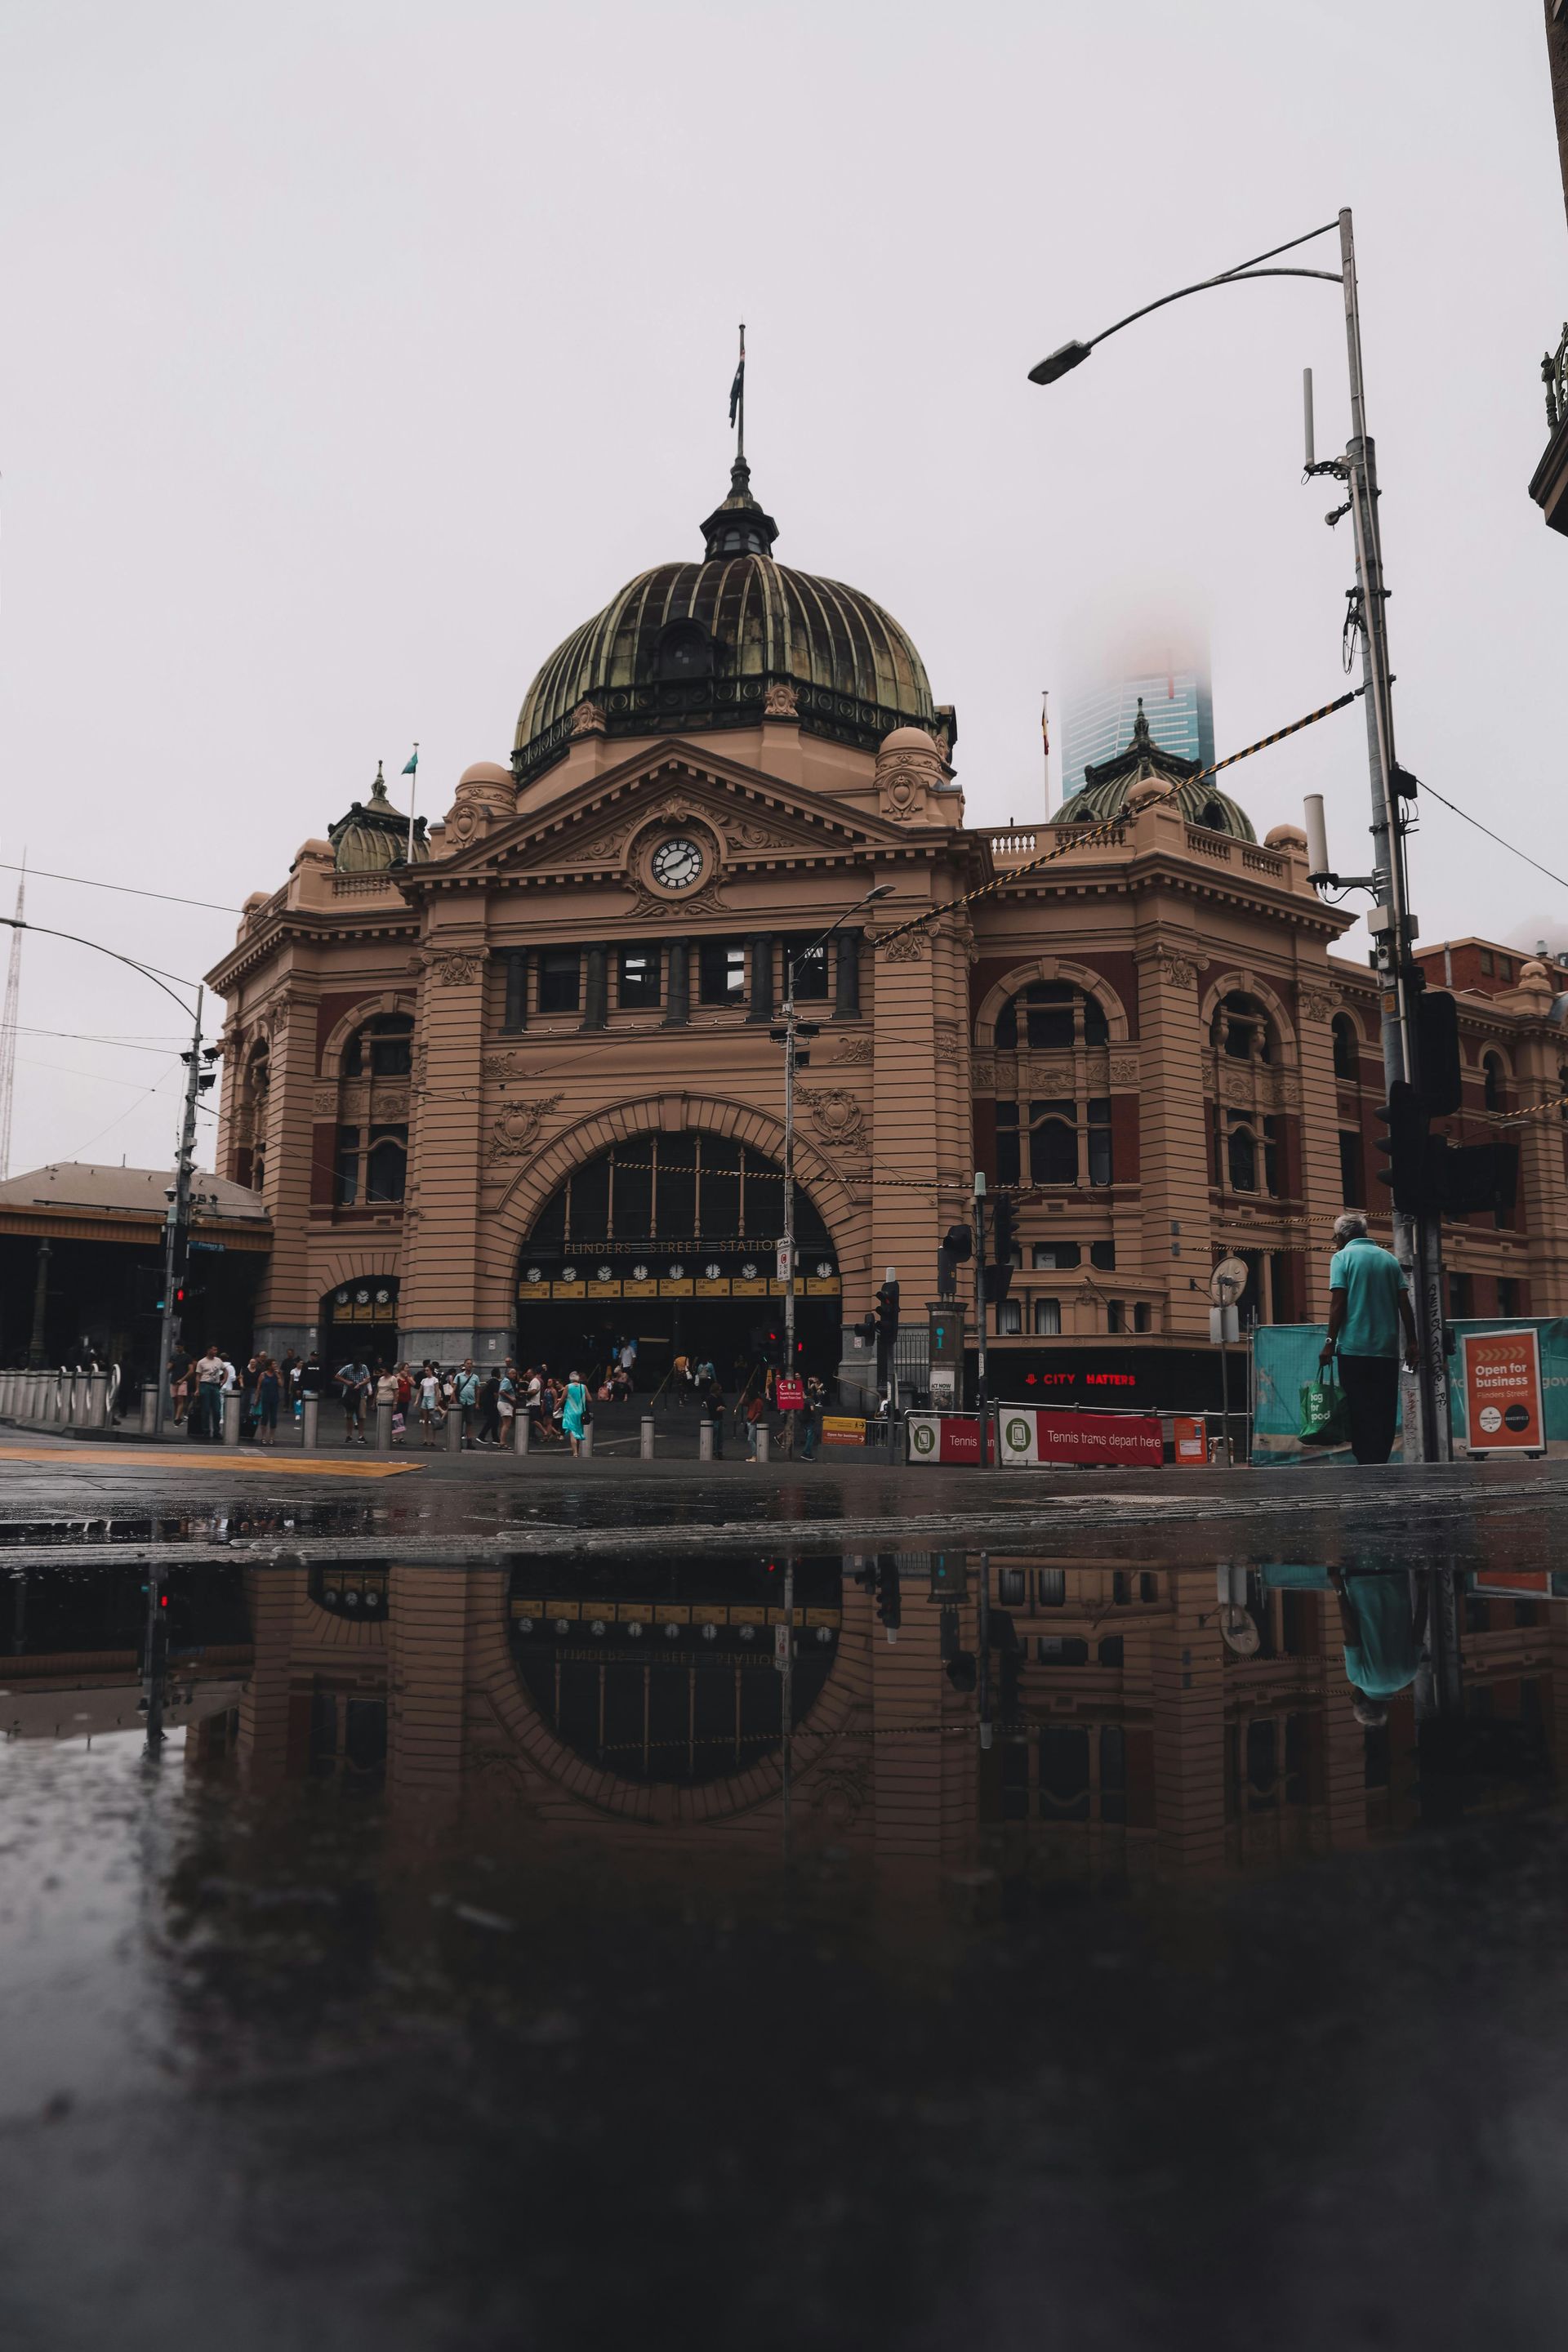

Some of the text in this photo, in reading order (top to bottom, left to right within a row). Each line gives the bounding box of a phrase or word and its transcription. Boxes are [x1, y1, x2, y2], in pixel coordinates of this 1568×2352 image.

[564, 1240, 777, 1254] FLINDERS STREET STATIO
[1475, 1362, 1527, 1376] Open for
[1043, 1374, 1136, 1386] CITY HATTERS
[1476, 1376, 1528, 1388] business
[1477, 1391, 1504, 1399] Flinders
[950, 1435, 978, 1446] Tennis
[1047, 1430, 1161, 1448] Tennis trams depart here
